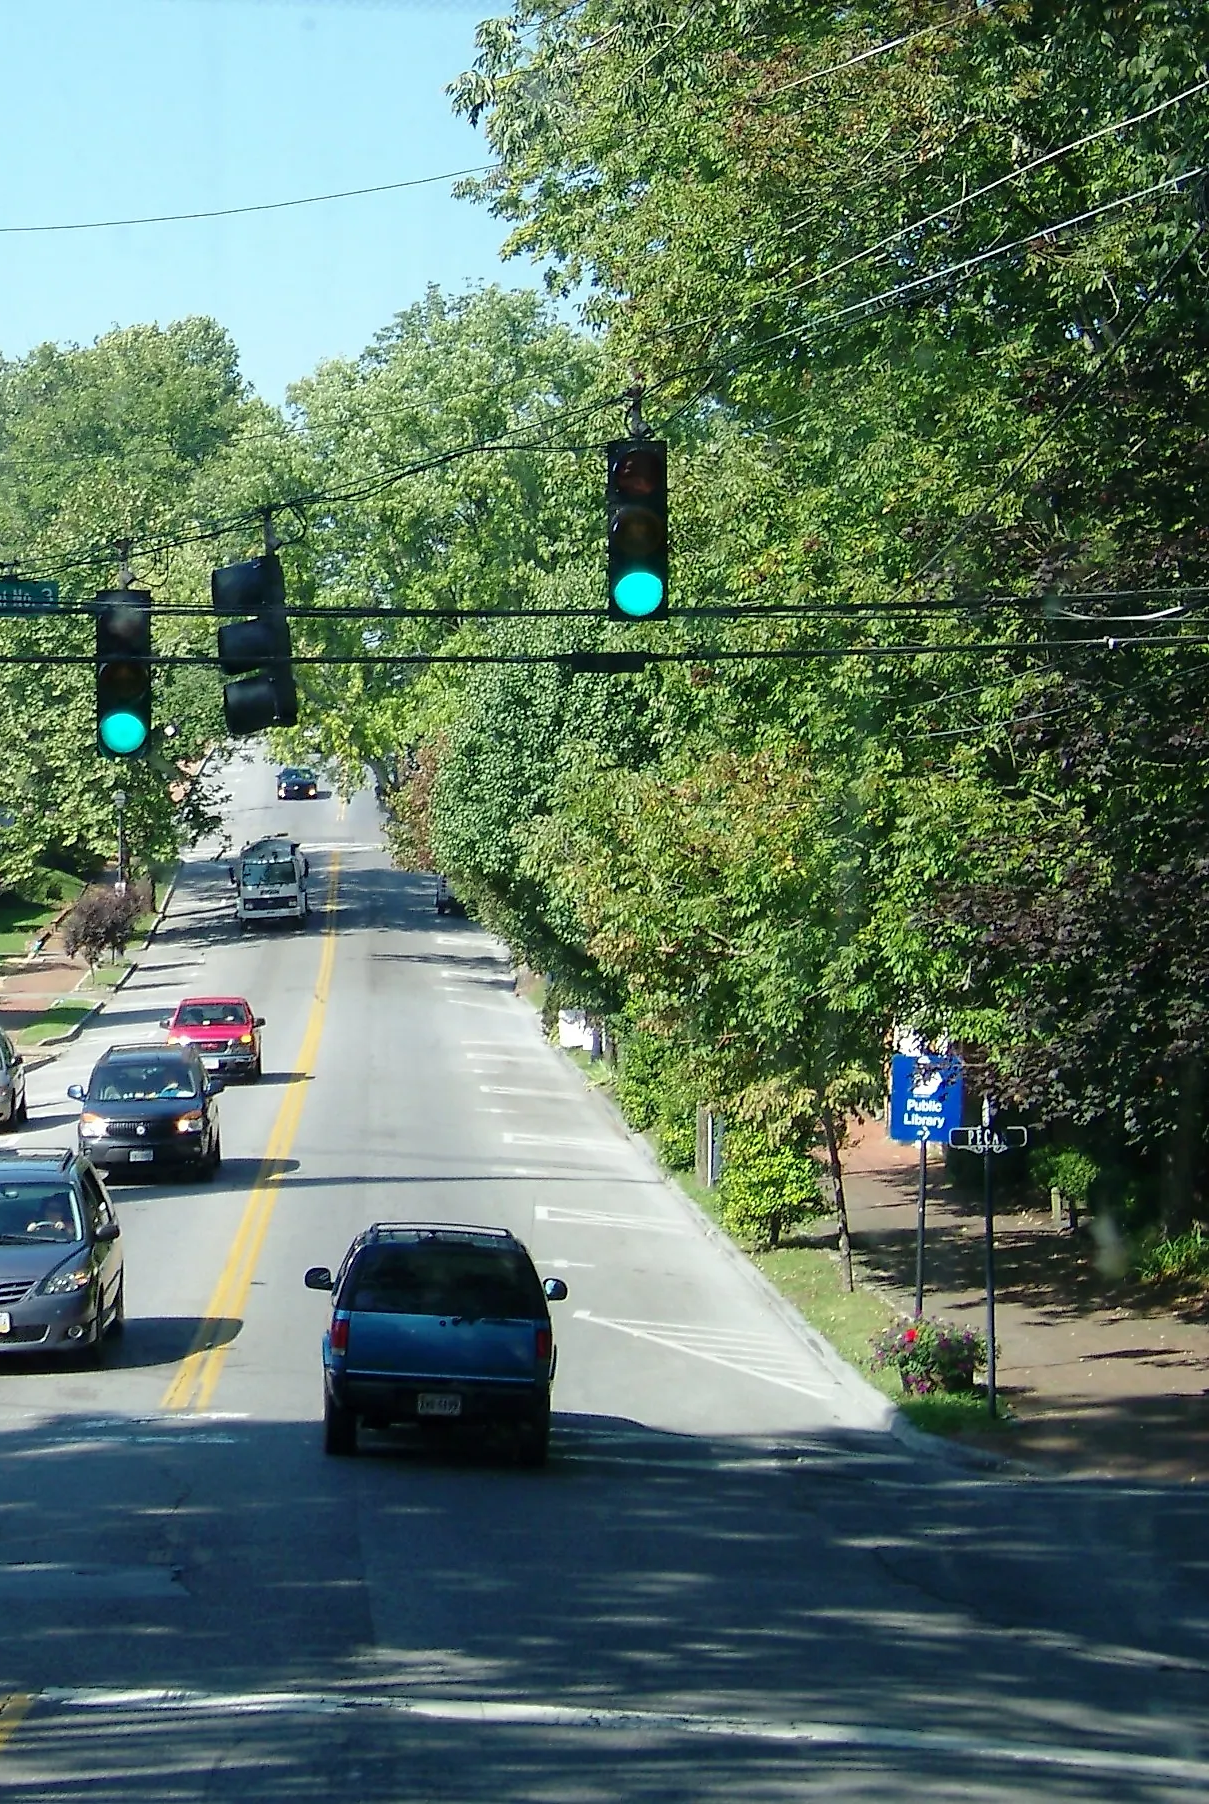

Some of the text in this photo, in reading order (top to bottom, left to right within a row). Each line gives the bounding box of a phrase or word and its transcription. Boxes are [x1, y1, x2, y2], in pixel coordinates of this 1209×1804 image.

[906, 1099, 942, 1113] Public
[903, 1113, 945, 1129] Library
[967, 1128, 1008, 1146] PECA
